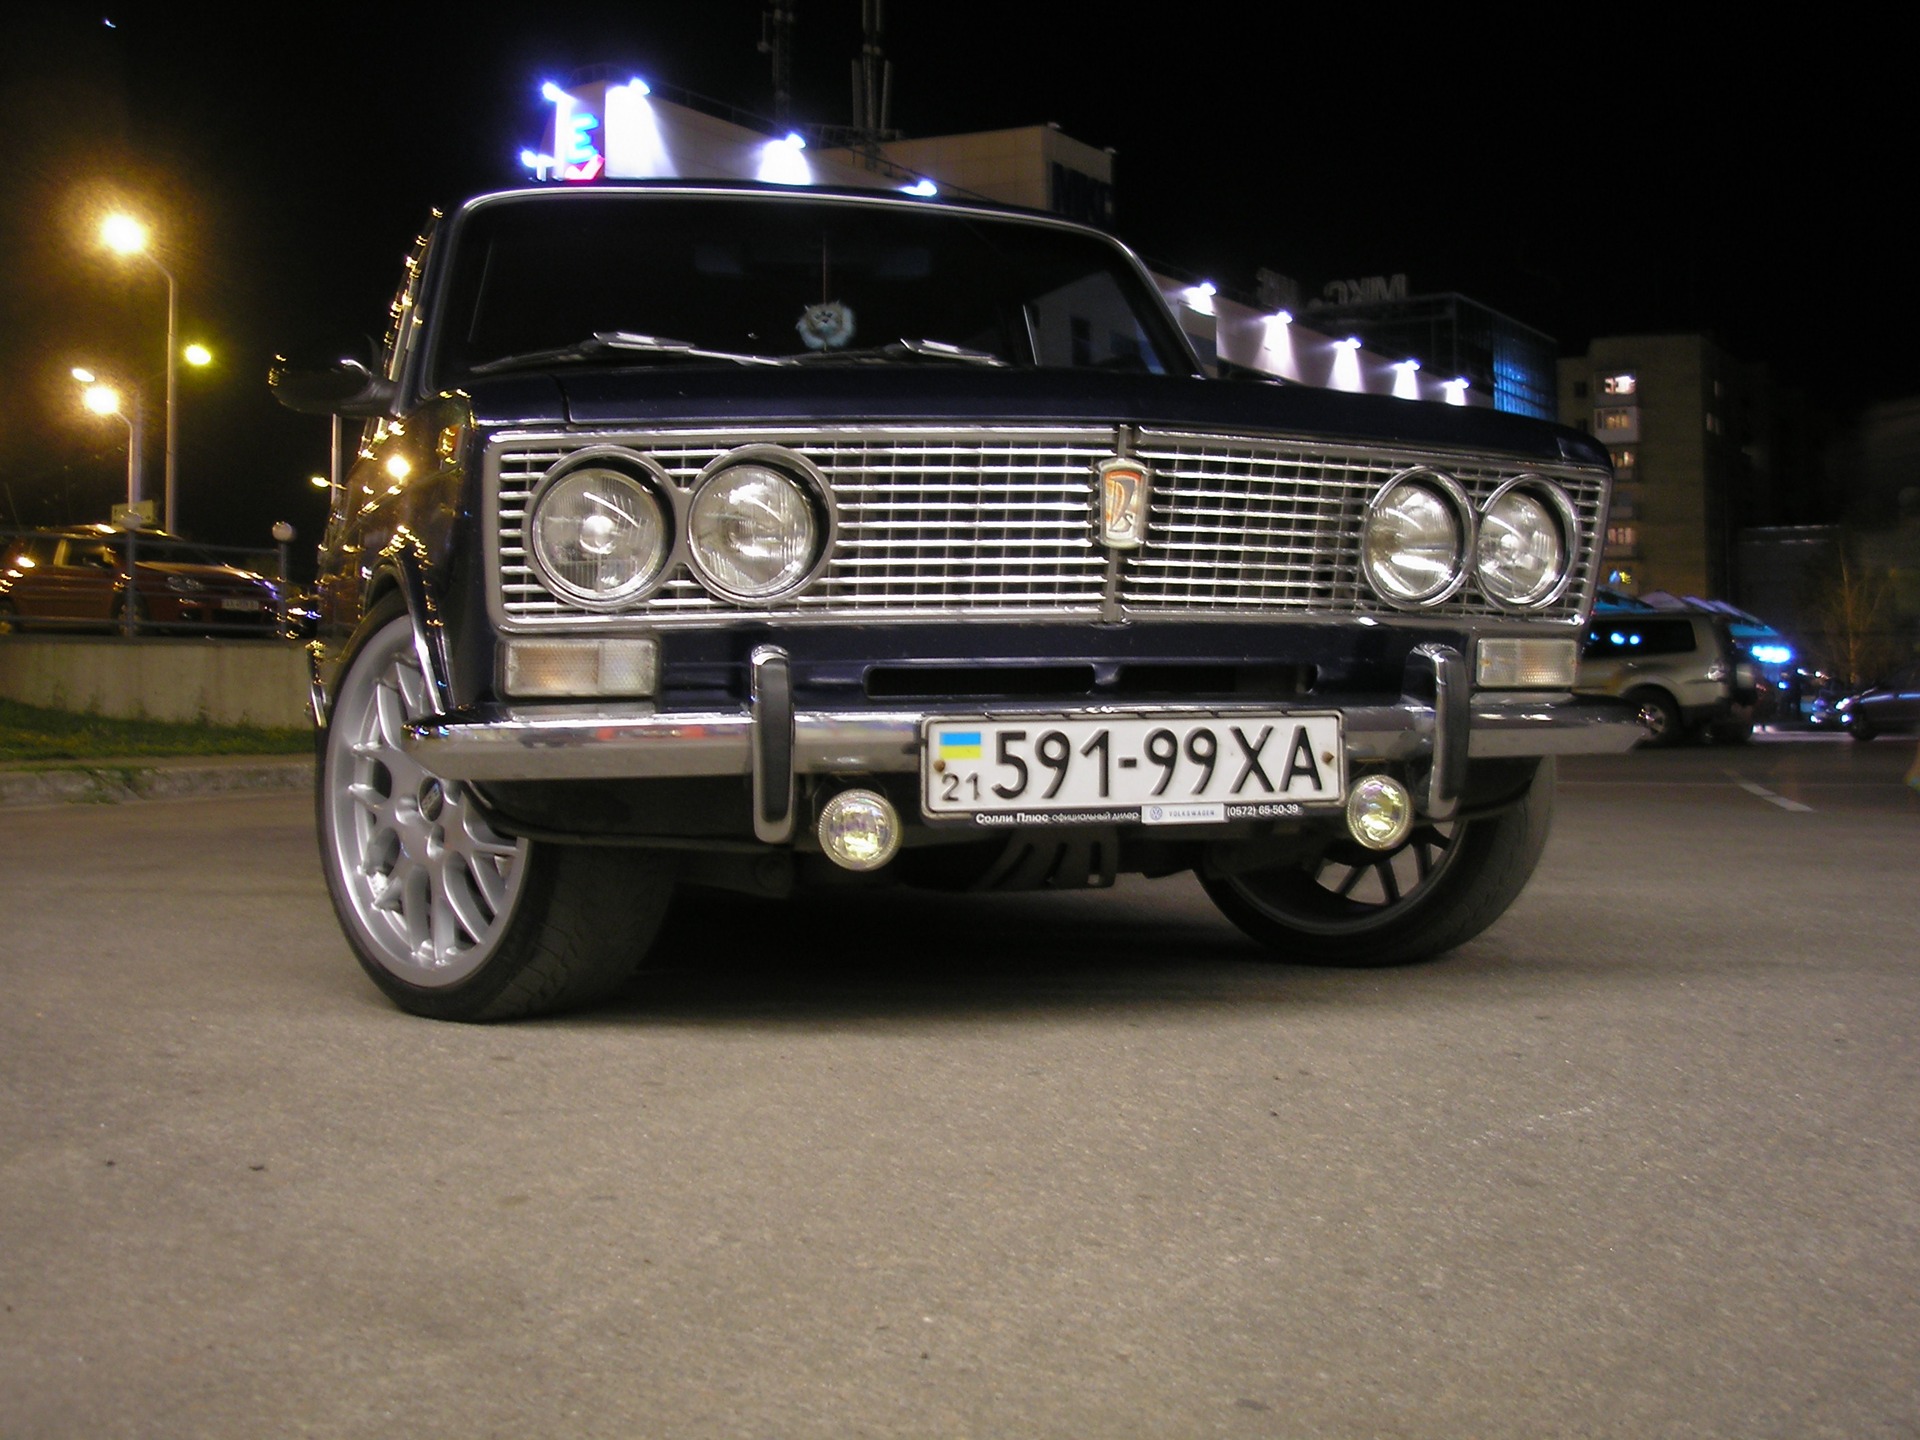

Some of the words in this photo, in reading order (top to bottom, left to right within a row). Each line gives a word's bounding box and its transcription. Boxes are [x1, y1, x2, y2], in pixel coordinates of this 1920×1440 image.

[940, 772, 981, 801] 21
[1168, 810, 1215, 818] VOLKSWAGEN
[1226, 805, 1256, 817] (0572)
[1258, 803, 1299, 815] 65-50-39
[975, 812, 1014, 824] Солли
